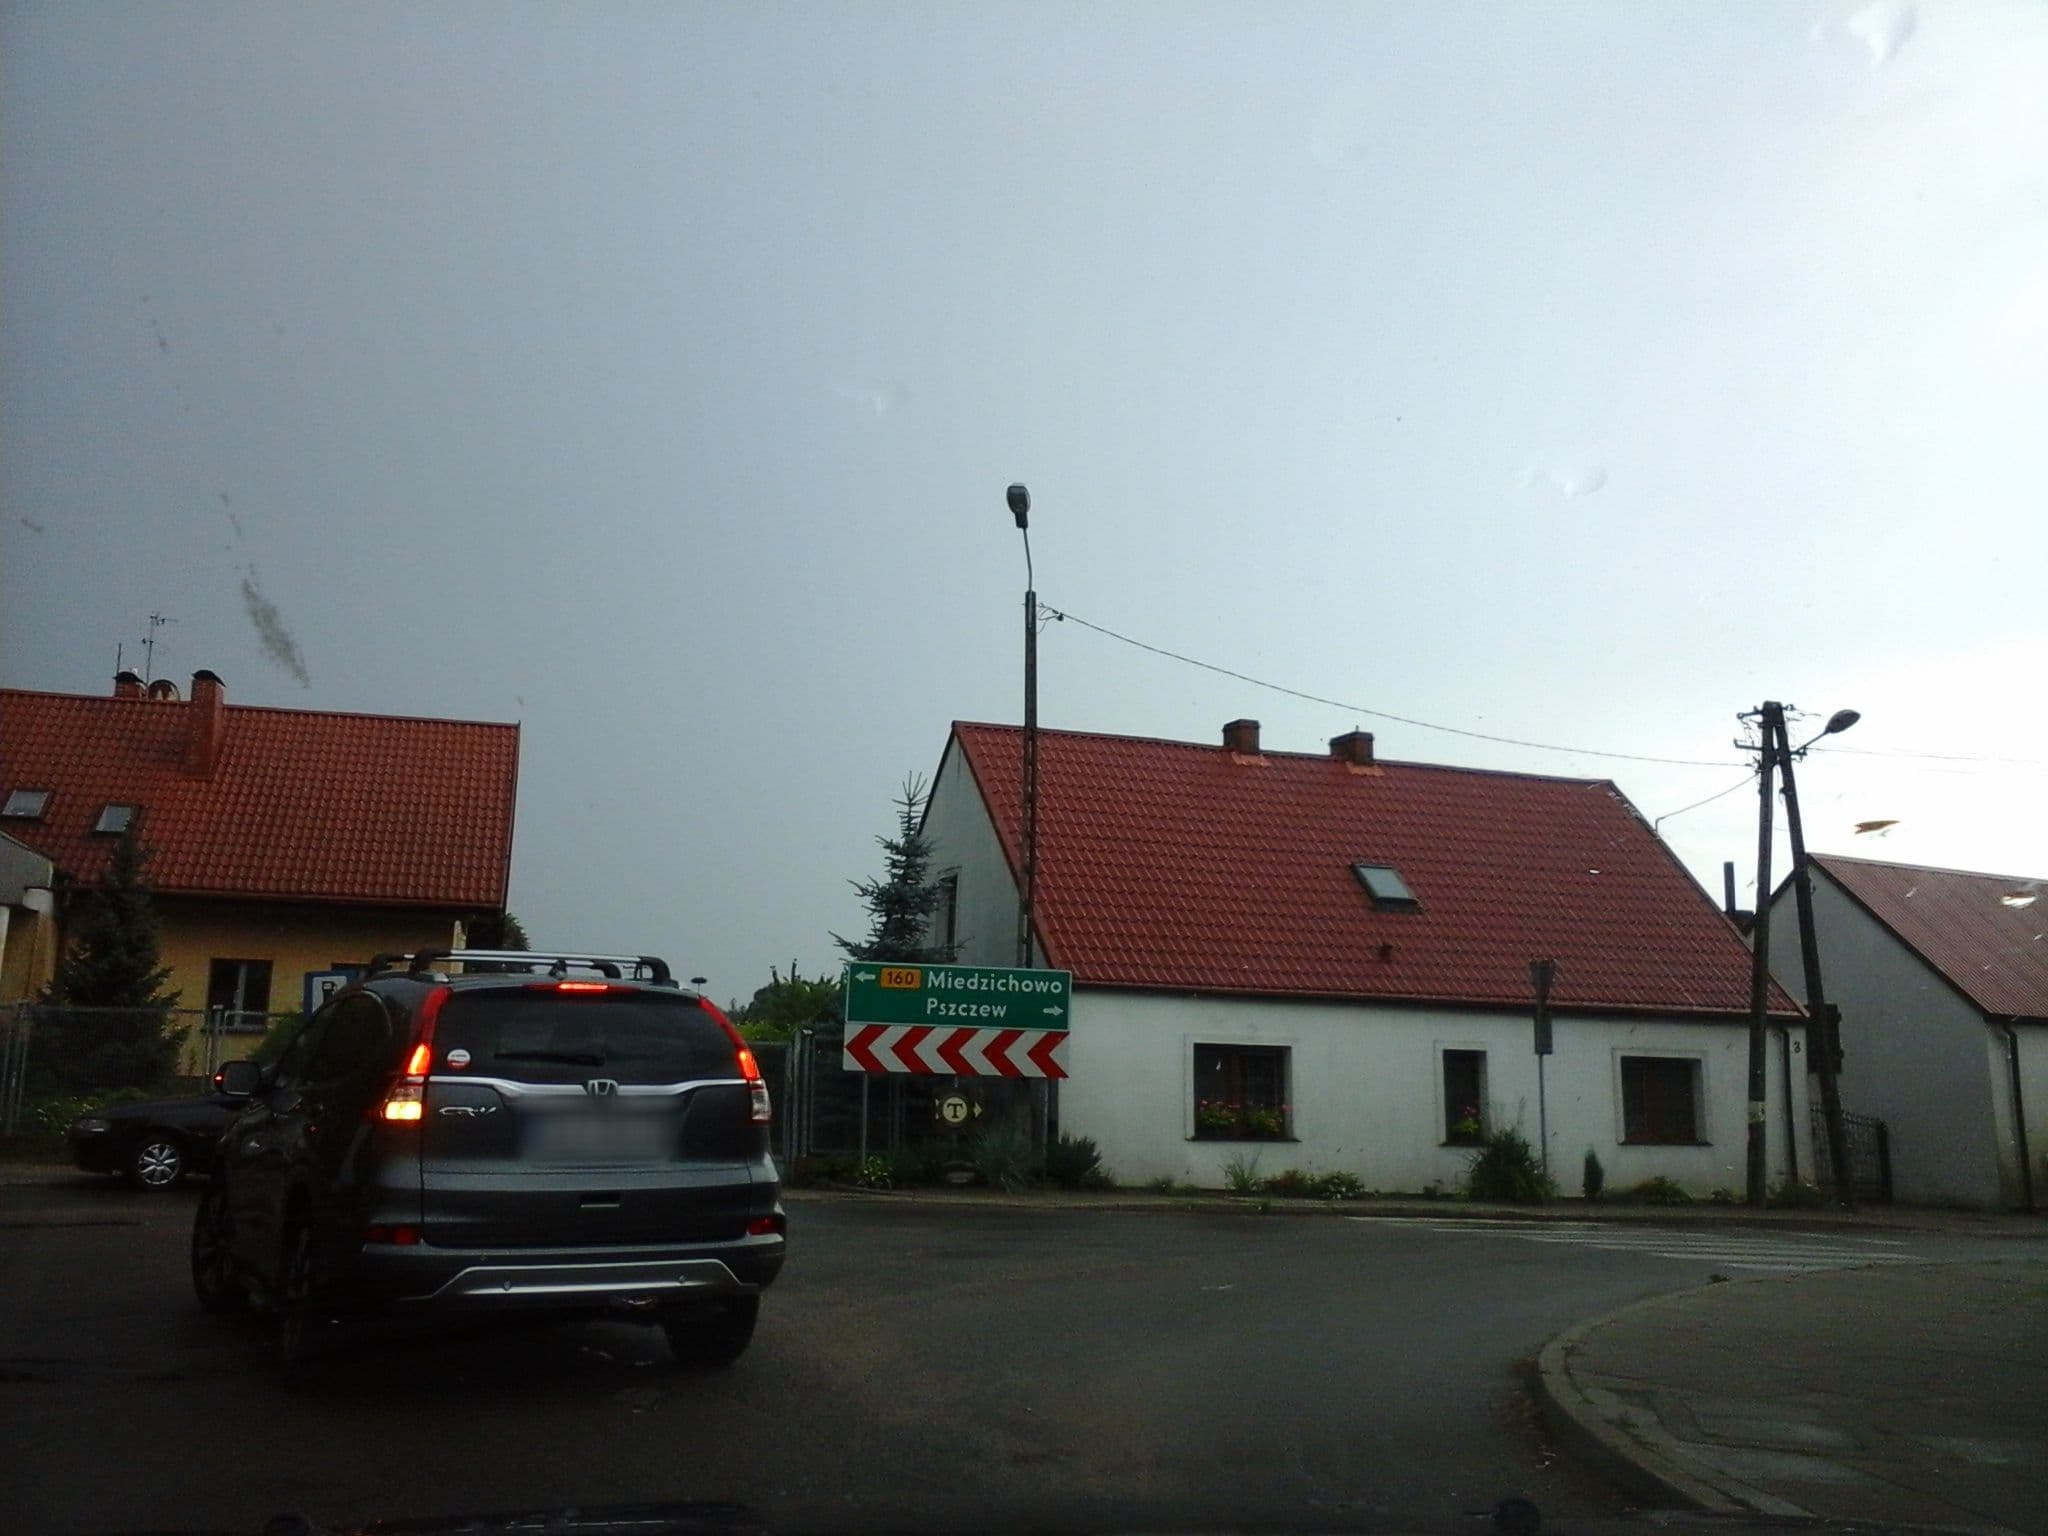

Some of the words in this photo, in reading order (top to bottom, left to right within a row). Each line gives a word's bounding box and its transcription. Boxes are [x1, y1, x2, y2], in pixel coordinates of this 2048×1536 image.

[887, 970, 915, 985] 160
[927, 970, 1063, 994] Miedzichowo
[926, 997, 1008, 1018] Pszczew
[946, 1102, 964, 1119] T
